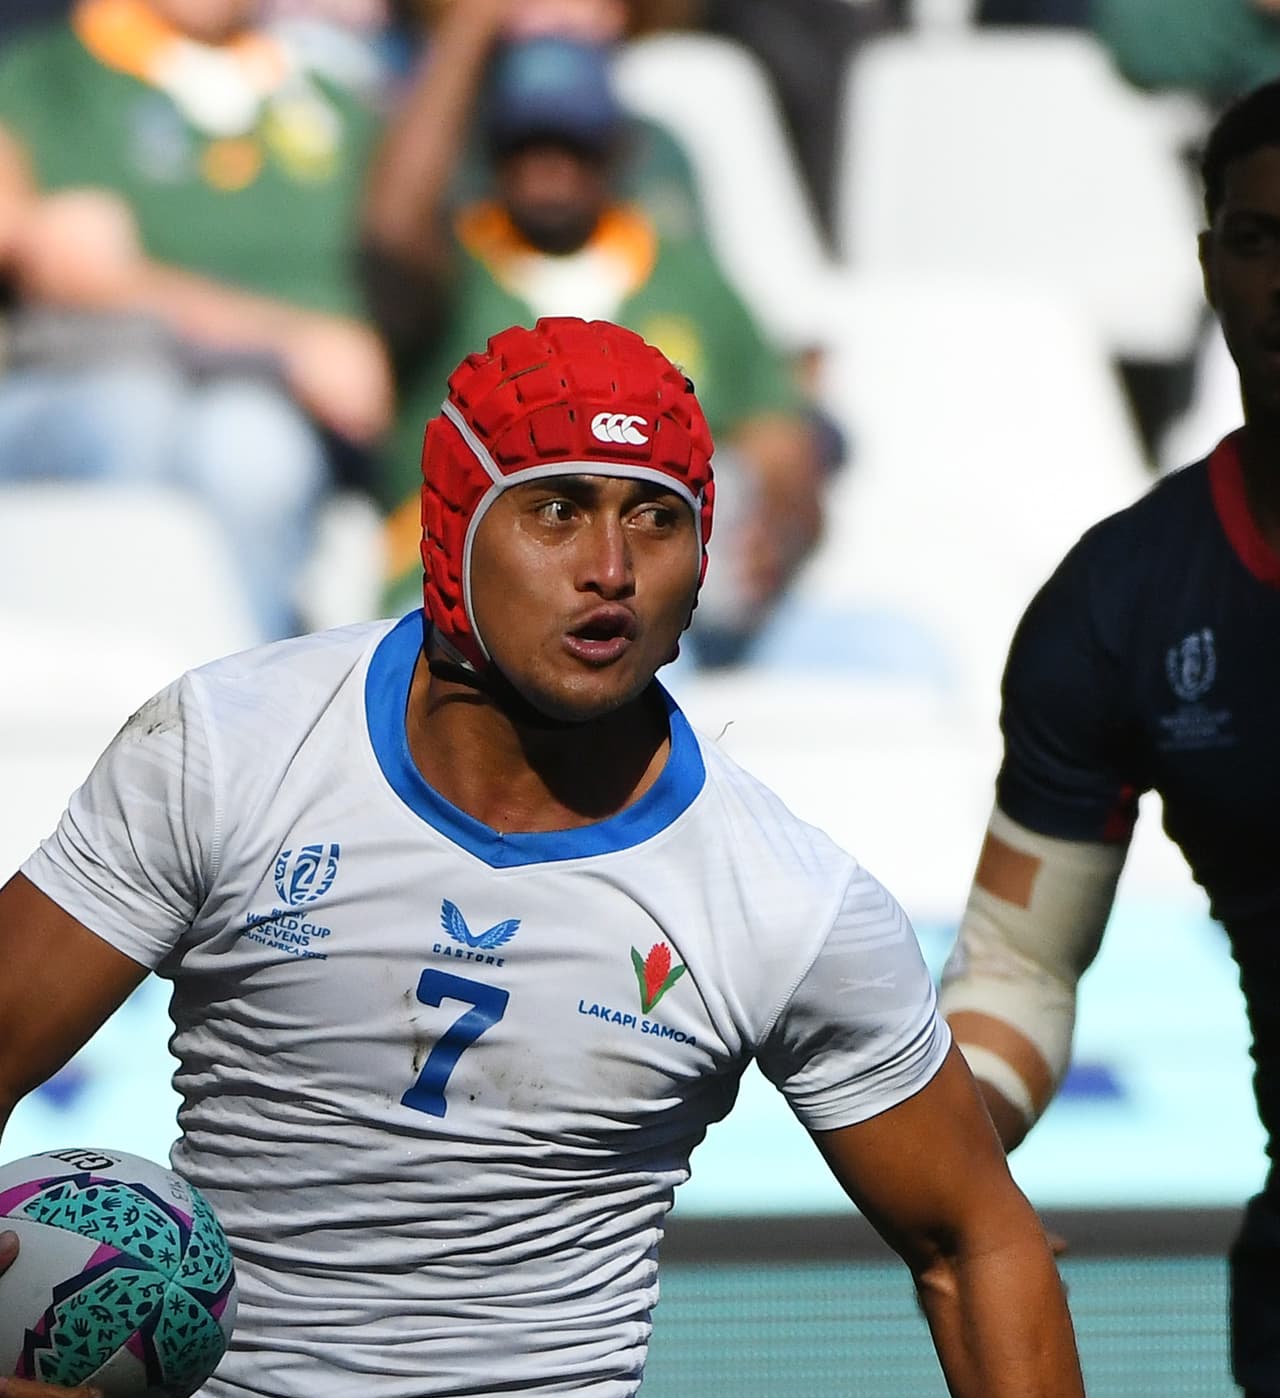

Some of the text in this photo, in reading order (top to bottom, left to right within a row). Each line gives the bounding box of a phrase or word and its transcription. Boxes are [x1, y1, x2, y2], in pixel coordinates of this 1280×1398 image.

[256, 924, 310, 946] SEVENS
[301, 923, 331, 939] CUP
[433, 943, 505, 967] CASTORE
[578, 999, 698, 1046] LAKAPI SAMOA
[401, 968, 510, 1118] 7
